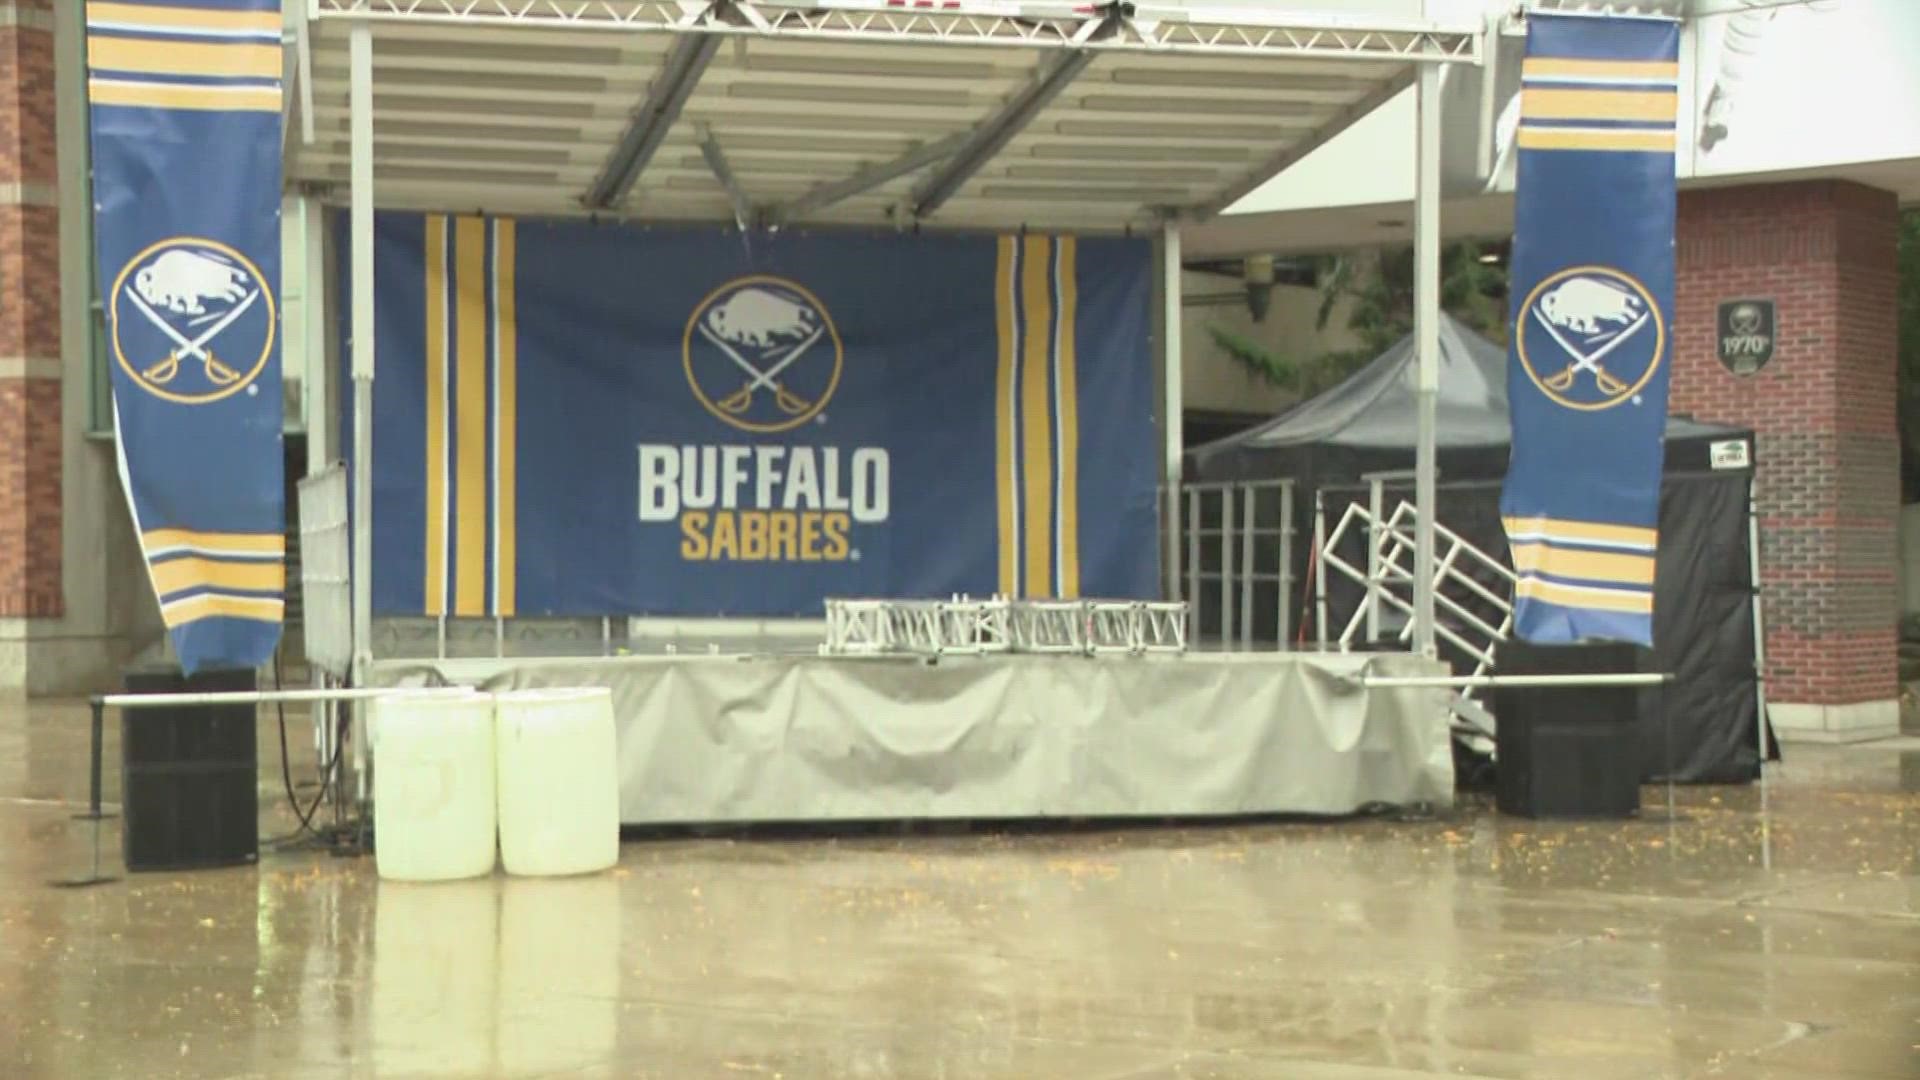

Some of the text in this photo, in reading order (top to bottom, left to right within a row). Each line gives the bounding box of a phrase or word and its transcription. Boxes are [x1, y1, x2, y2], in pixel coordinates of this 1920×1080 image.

[1723, 335, 1764, 354] 1970
[638, 444, 890, 522] BUFFALO
[681, 511, 850, 561] SABRES
